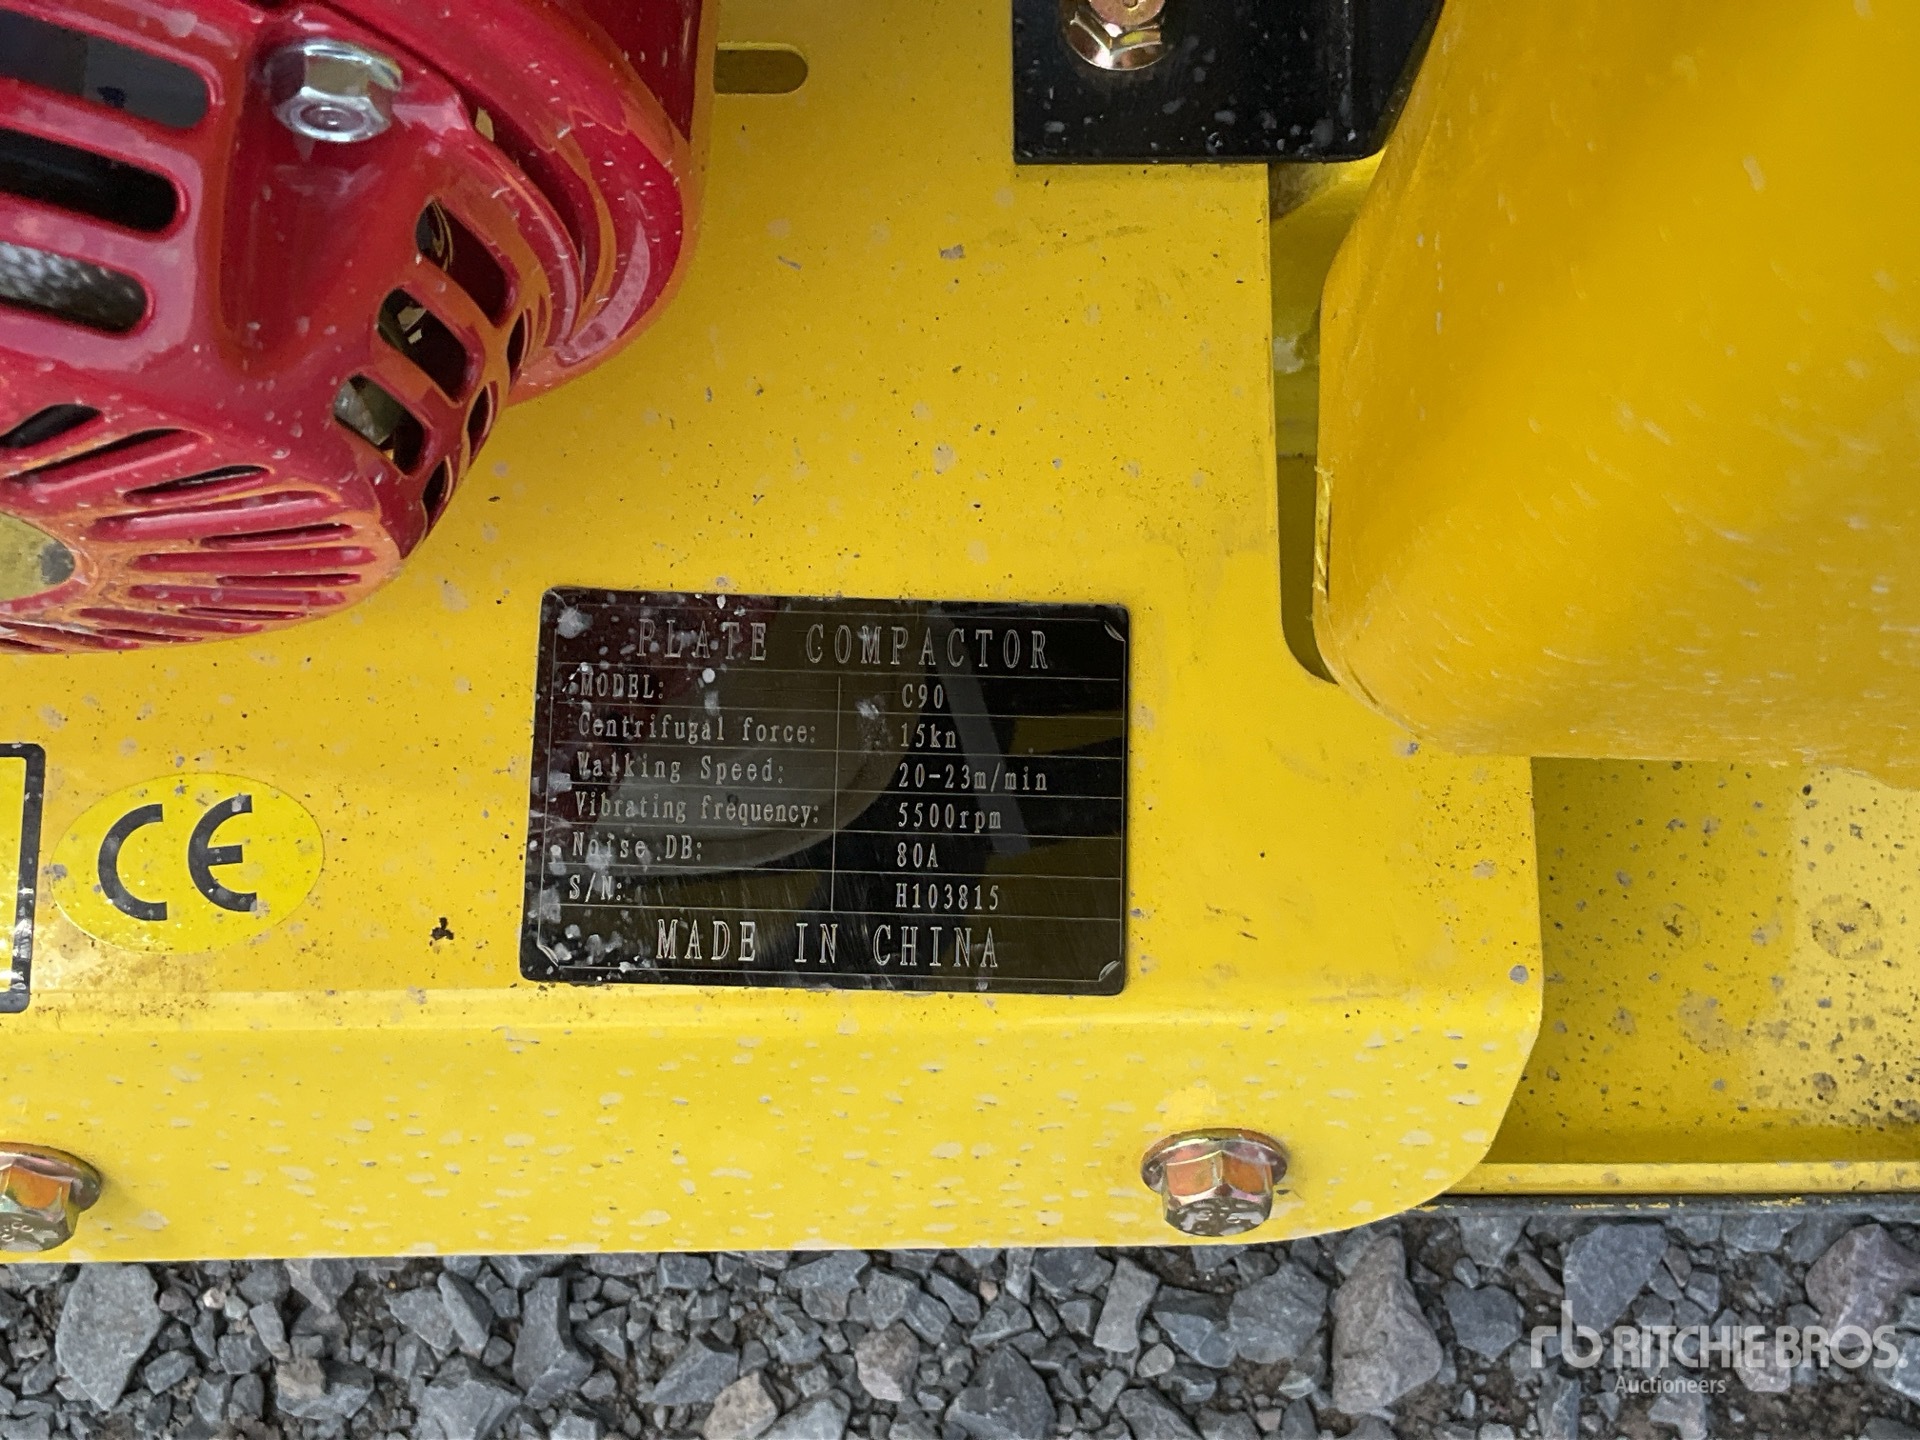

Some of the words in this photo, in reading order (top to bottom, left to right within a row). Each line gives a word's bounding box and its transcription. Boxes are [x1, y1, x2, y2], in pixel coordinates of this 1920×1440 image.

[637, 618, 767, 661] PLATE
[806, 623, 1049, 669] COMPACTOR
[580, 672, 664, 699] MODEL:
[902, 683, 944, 709] C90
[579, 711, 725, 745] Centrifugal
[742, 717, 816, 744] force:
[900, 723, 957, 749] 15kn
[576, 751, 681, 783] Walking
[700, 755, 784, 785] Speed:
[898, 762, 1048, 792] 20-23m/min
[575, 791, 687, 823] Vibrating
[700, 794, 819, 828] frequency:
[898, 802, 1001, 833] 5500rpm
[897, 842, 938, 868] 80A
[569, 874, 622, 902] S/N:
[896, 883, 999, 911] H103815
[655, 918, 757, 962] MADE
[794, 922, 838, 964] IN
[872, 924, 998, 968] CHINA
